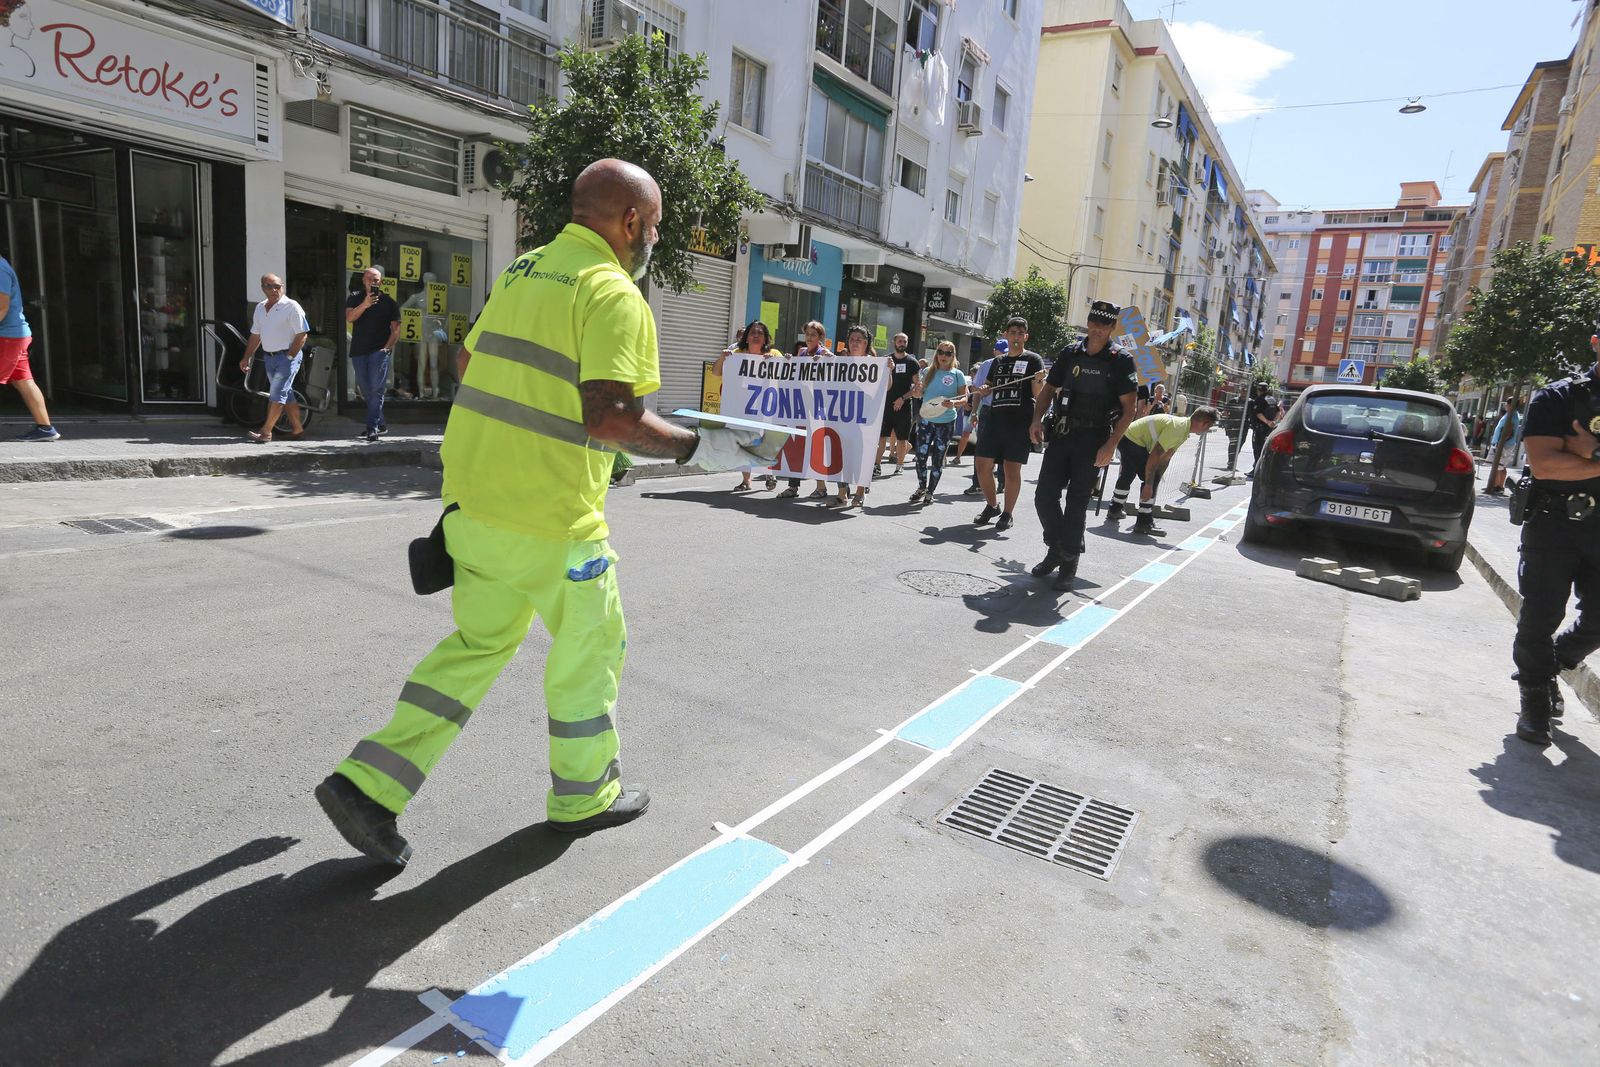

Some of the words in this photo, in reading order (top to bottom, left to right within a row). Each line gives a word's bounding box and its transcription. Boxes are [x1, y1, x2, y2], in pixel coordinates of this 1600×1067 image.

[349, 236, 369, 246] TODO
[402, 247, 420, 256] TODO
[453, 255, 470, 263] TODO
[530, 271, 578, 287] movilidad
[429, 283, 446, 292] TODO
[928, 300, 946, 309] Q&R
[403, 309, 421, 317] TODO
[738, 359, 796, 381] ALCALDE
[798, 360, 879, 383] MENTIROSO
[744, 384, 807, 420] ZONA
[813, 389, 867, 424] AZUL
[768, 425, 844, 475] NO
[1340, 468, 1387, 479] ALTEA
[1328, 503, 1359, 516] 9181
[1363, 508, 1390, 521] FGT
